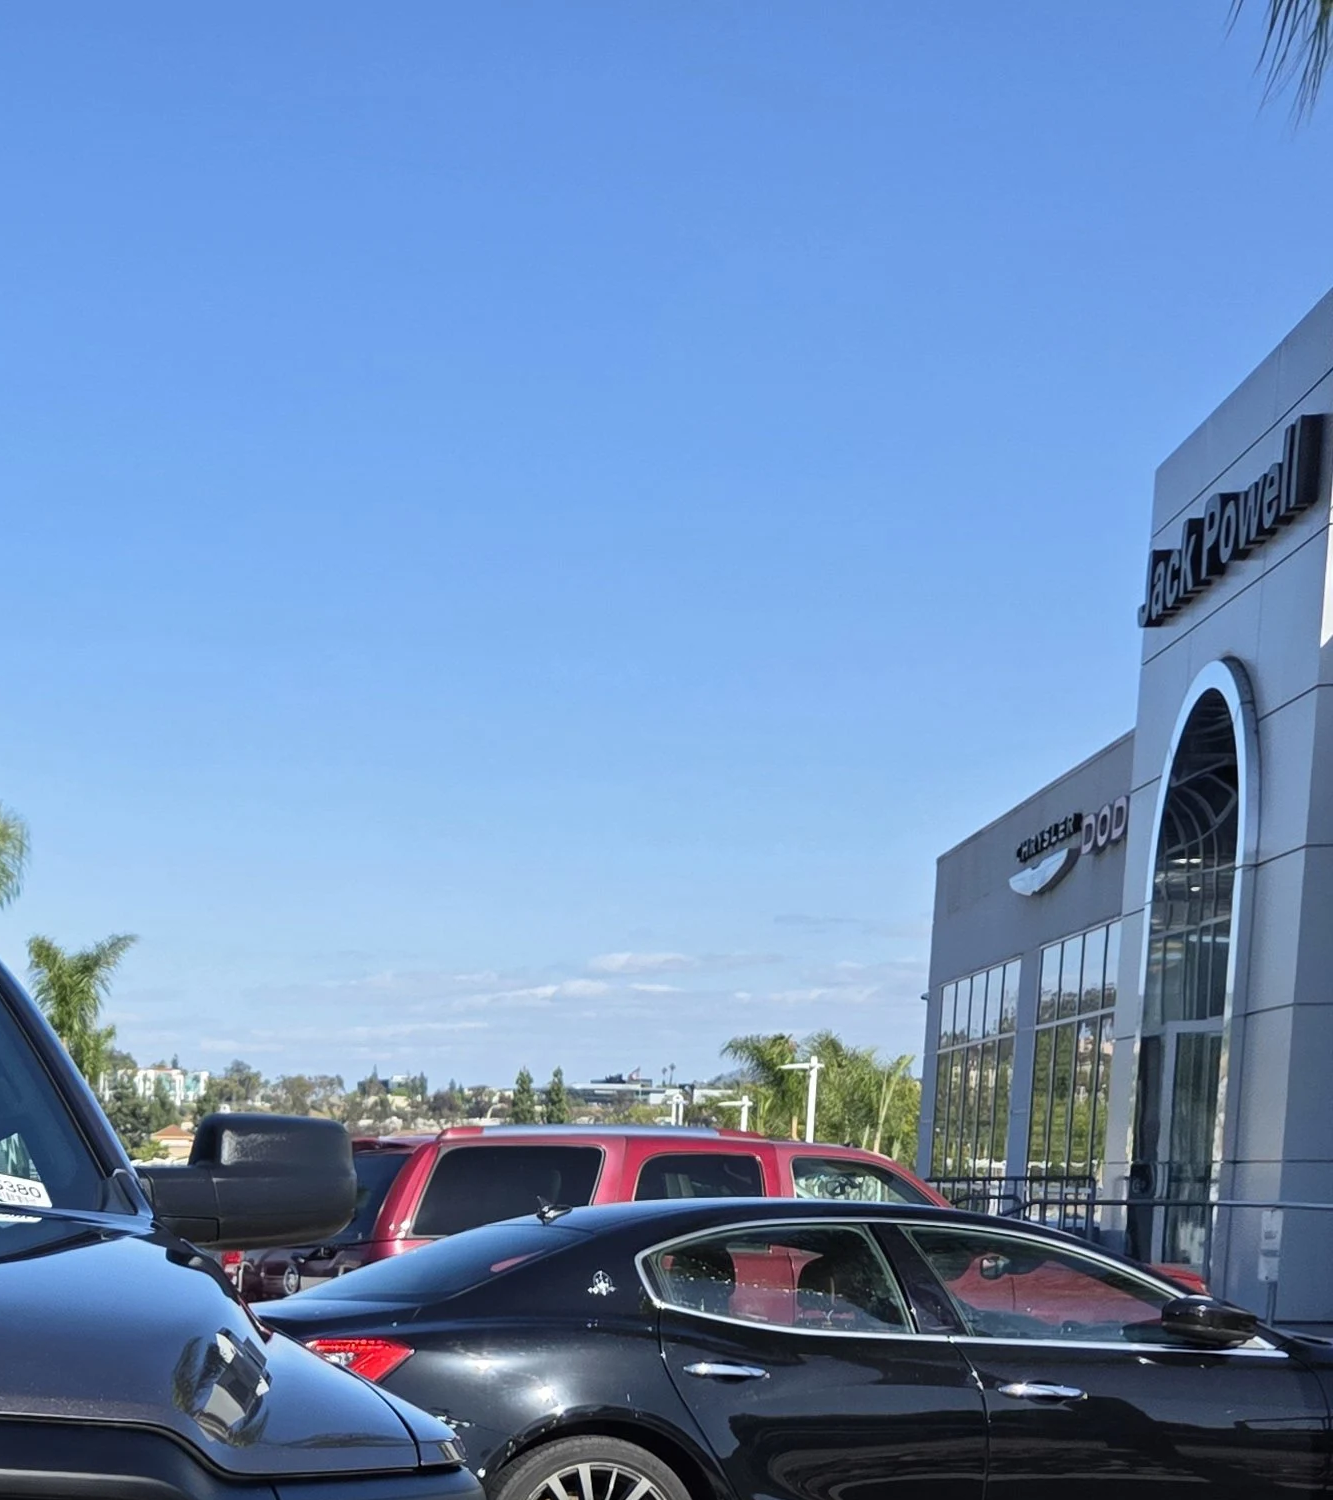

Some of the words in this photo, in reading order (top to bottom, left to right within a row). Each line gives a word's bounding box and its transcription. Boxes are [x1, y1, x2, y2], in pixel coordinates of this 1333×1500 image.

[1138, 518, 1201, 627] Jack
[1201, 414, 1311, 580] Powell
[1017, 814, 1079, 861] HRYSLER
